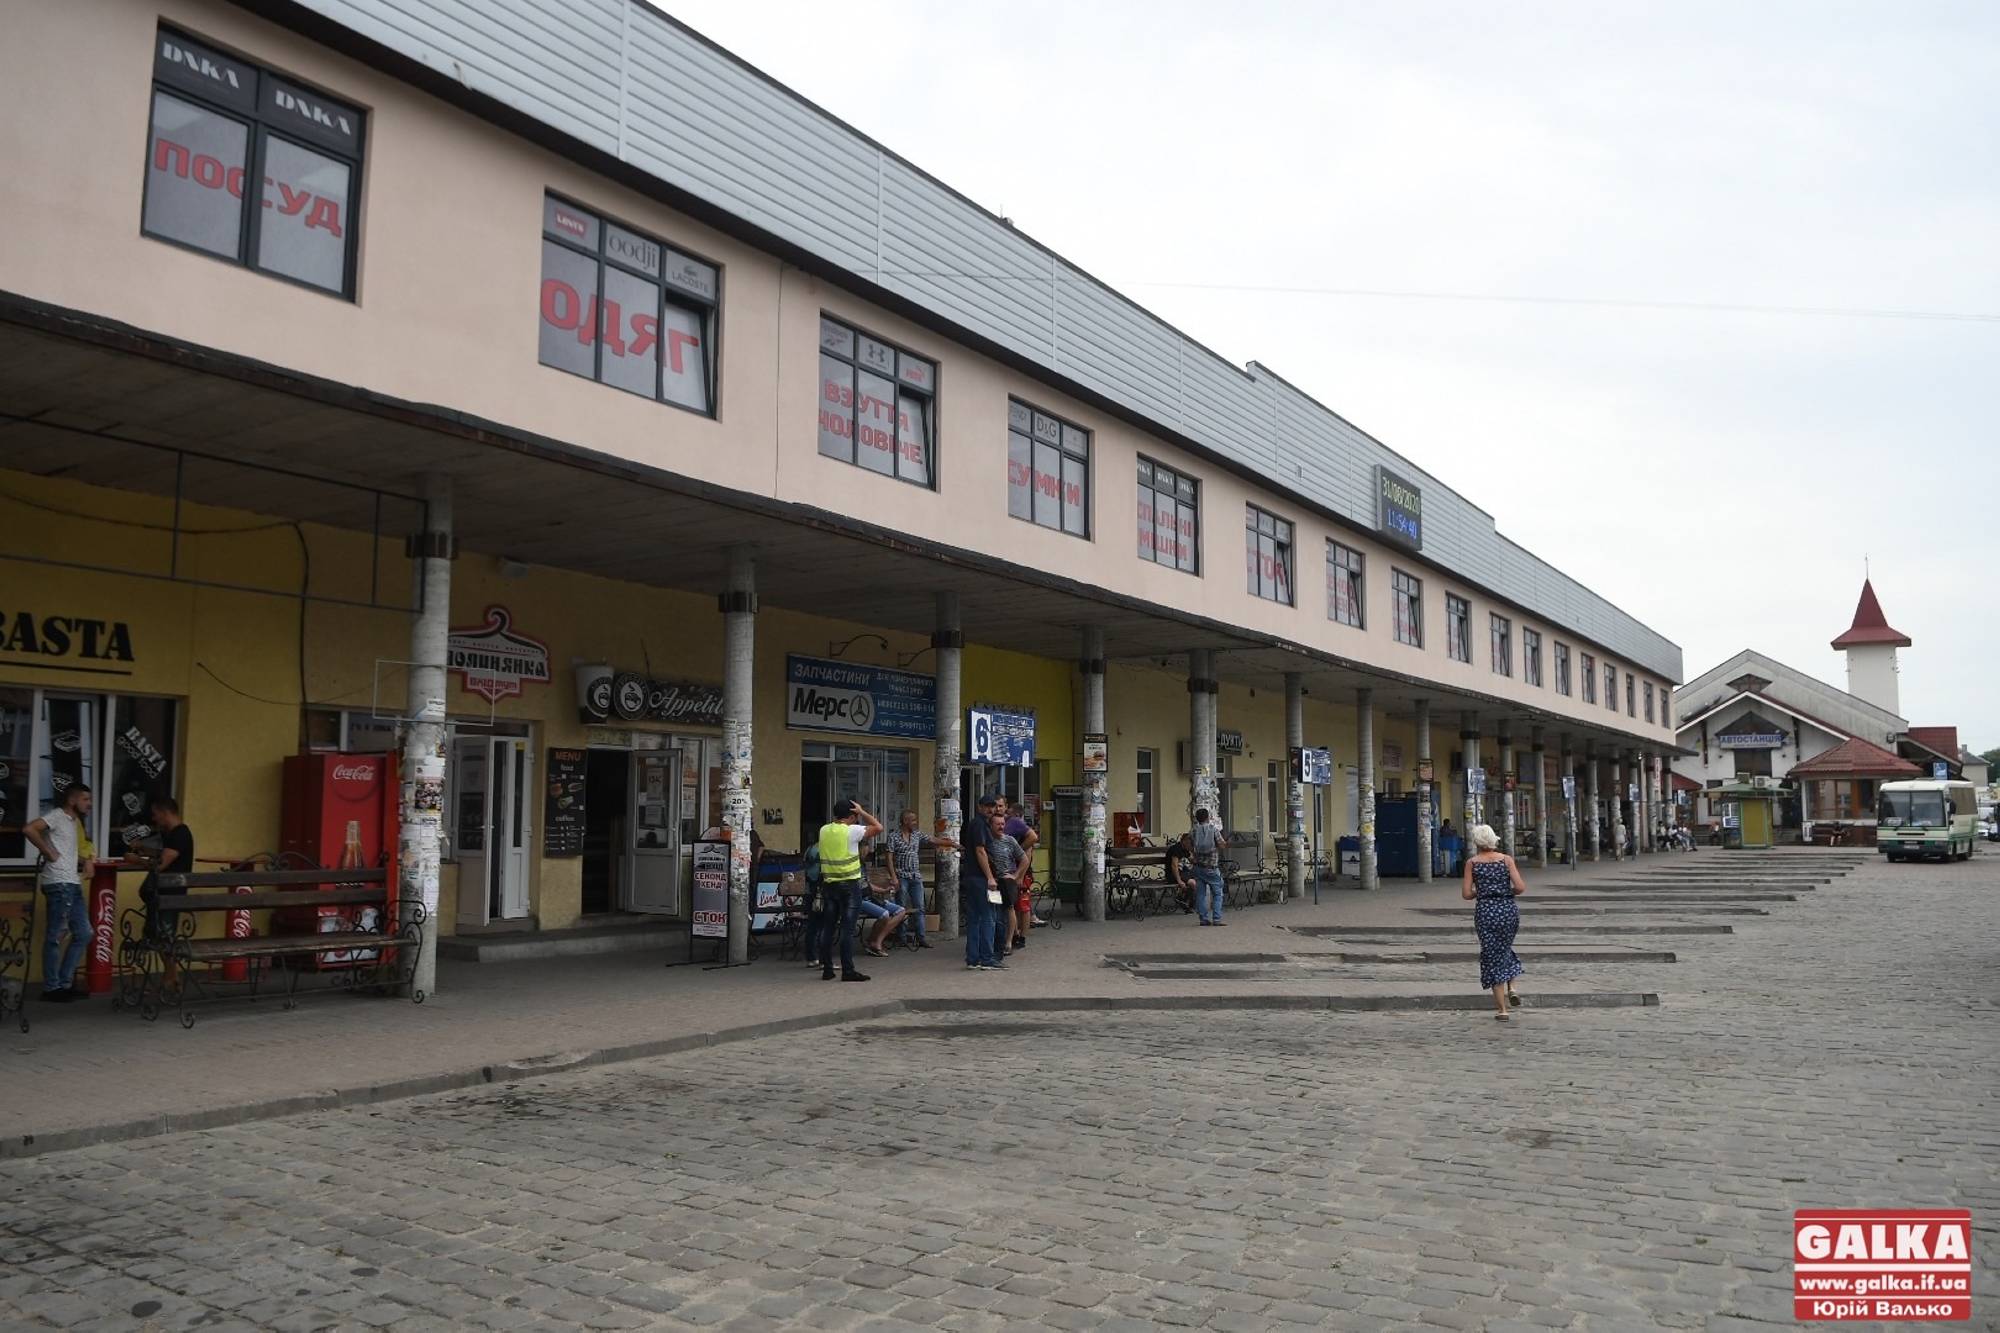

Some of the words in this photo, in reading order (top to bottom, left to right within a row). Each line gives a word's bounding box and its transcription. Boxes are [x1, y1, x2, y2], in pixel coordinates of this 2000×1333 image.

[154, 137, 343, 239] ПОСУД
[609, 234, 657, 269] oodji
[540, 278, 699, 375] ОДЯГ
[825, 379, 909, 433] ВЗУТТЯ
[795, 663, 870, 686] ЗАПЧАСТИНИ
[793, 688, 849, 721] Мерс
[976, 717, 989, 753] 6
[1721, 735, 1782, 744] АВТОСТАНЦІЯ
[125, 726, 168, 773] BASTA
[555, 750, 582, 762] MENU
[332, 764, 375, 782] Coca-Cola
[1304, 752, 1311, 776] 5
[695, 873, 727, 882] СЕКОНД
[701, 881, 722, 889] ХЕНД
[694, 911, 727, 924] СТОК
